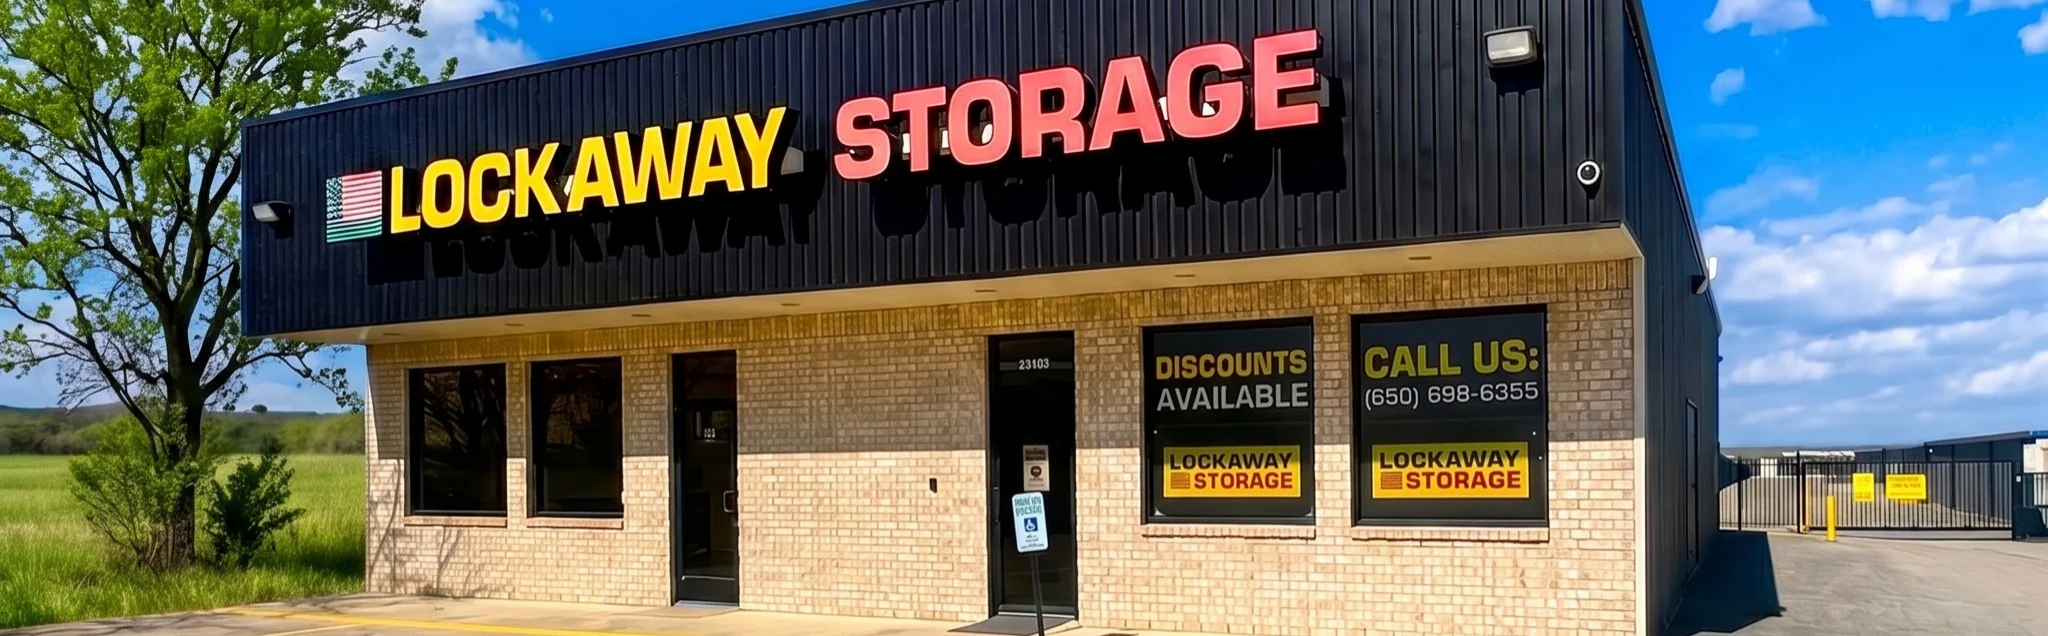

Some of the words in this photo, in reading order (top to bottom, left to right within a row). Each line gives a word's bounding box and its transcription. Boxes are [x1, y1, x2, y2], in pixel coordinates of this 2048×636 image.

[391, 106, 787, 234] LOCKAWAY
[834, 29, 1319, 180] STORAGE
[1018, 358, 1050, 370] 23103
[1156, 350, 1307, 380] DISCOUNTS
[1364, 343, 1461, 379] CALL
[1473, 339, 1539, 374] US:
[1156, 382, 1309, 411] AVAILABLE
[1365, 386, 1419, 411] (650)
[1428, 382, 1539, 404] 698-6355
[1170, 452, 1293, 470] LOCKAWAY
[1380, 450, 1520, 469] LOCKAWAY
[1194, 472, 1293, 489] STORAGE
[1406, 471, 1521, 489] STORAGE
